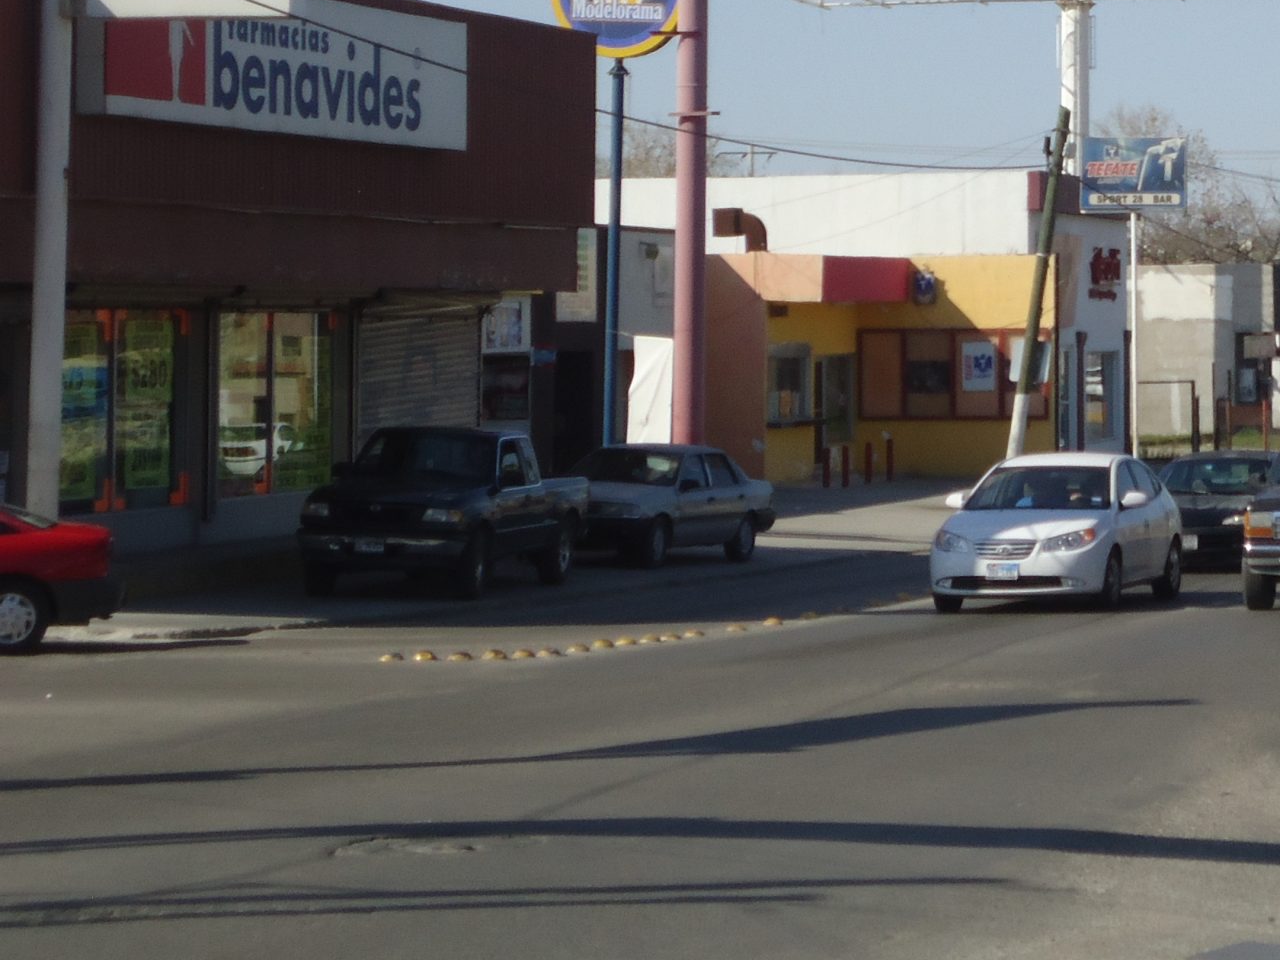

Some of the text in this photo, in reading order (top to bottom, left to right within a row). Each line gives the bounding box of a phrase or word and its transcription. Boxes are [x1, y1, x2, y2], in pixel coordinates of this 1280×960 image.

[213, 19, 422, 132] benavides
[1087, 161, 1138, 177] TECATE
[1096, 194, 1128, 204] SPORT
[1152, 194, 1173, 204] BAR
